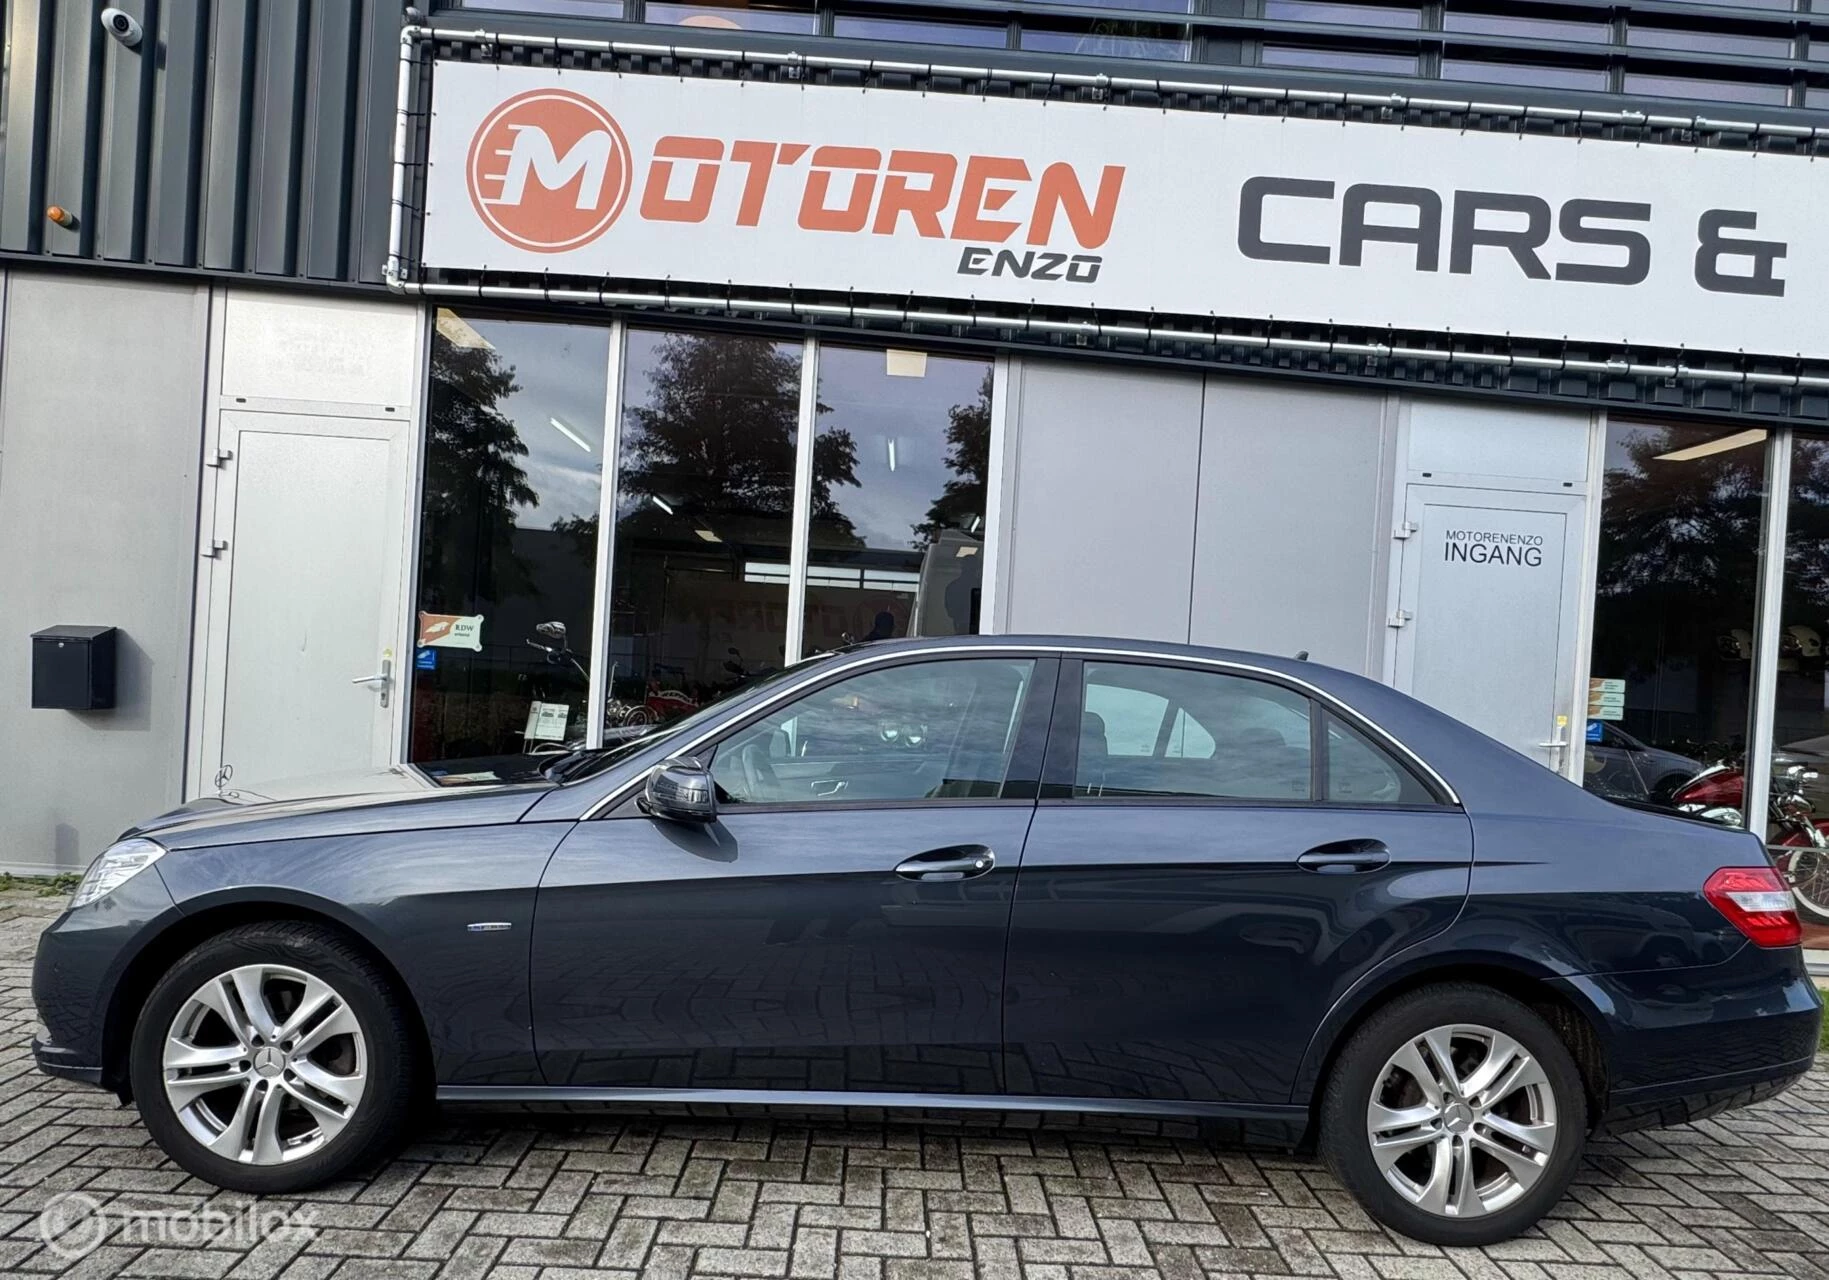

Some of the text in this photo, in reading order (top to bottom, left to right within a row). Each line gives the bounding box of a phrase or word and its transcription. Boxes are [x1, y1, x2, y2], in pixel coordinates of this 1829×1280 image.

[1237, 176, 1788, 297] CARS &
[957, 246, 1103, 283] ENZO
[1446, 530, 1543, 546] MOTORENENZO
[1445, 542, 1542, 566] INGANG
